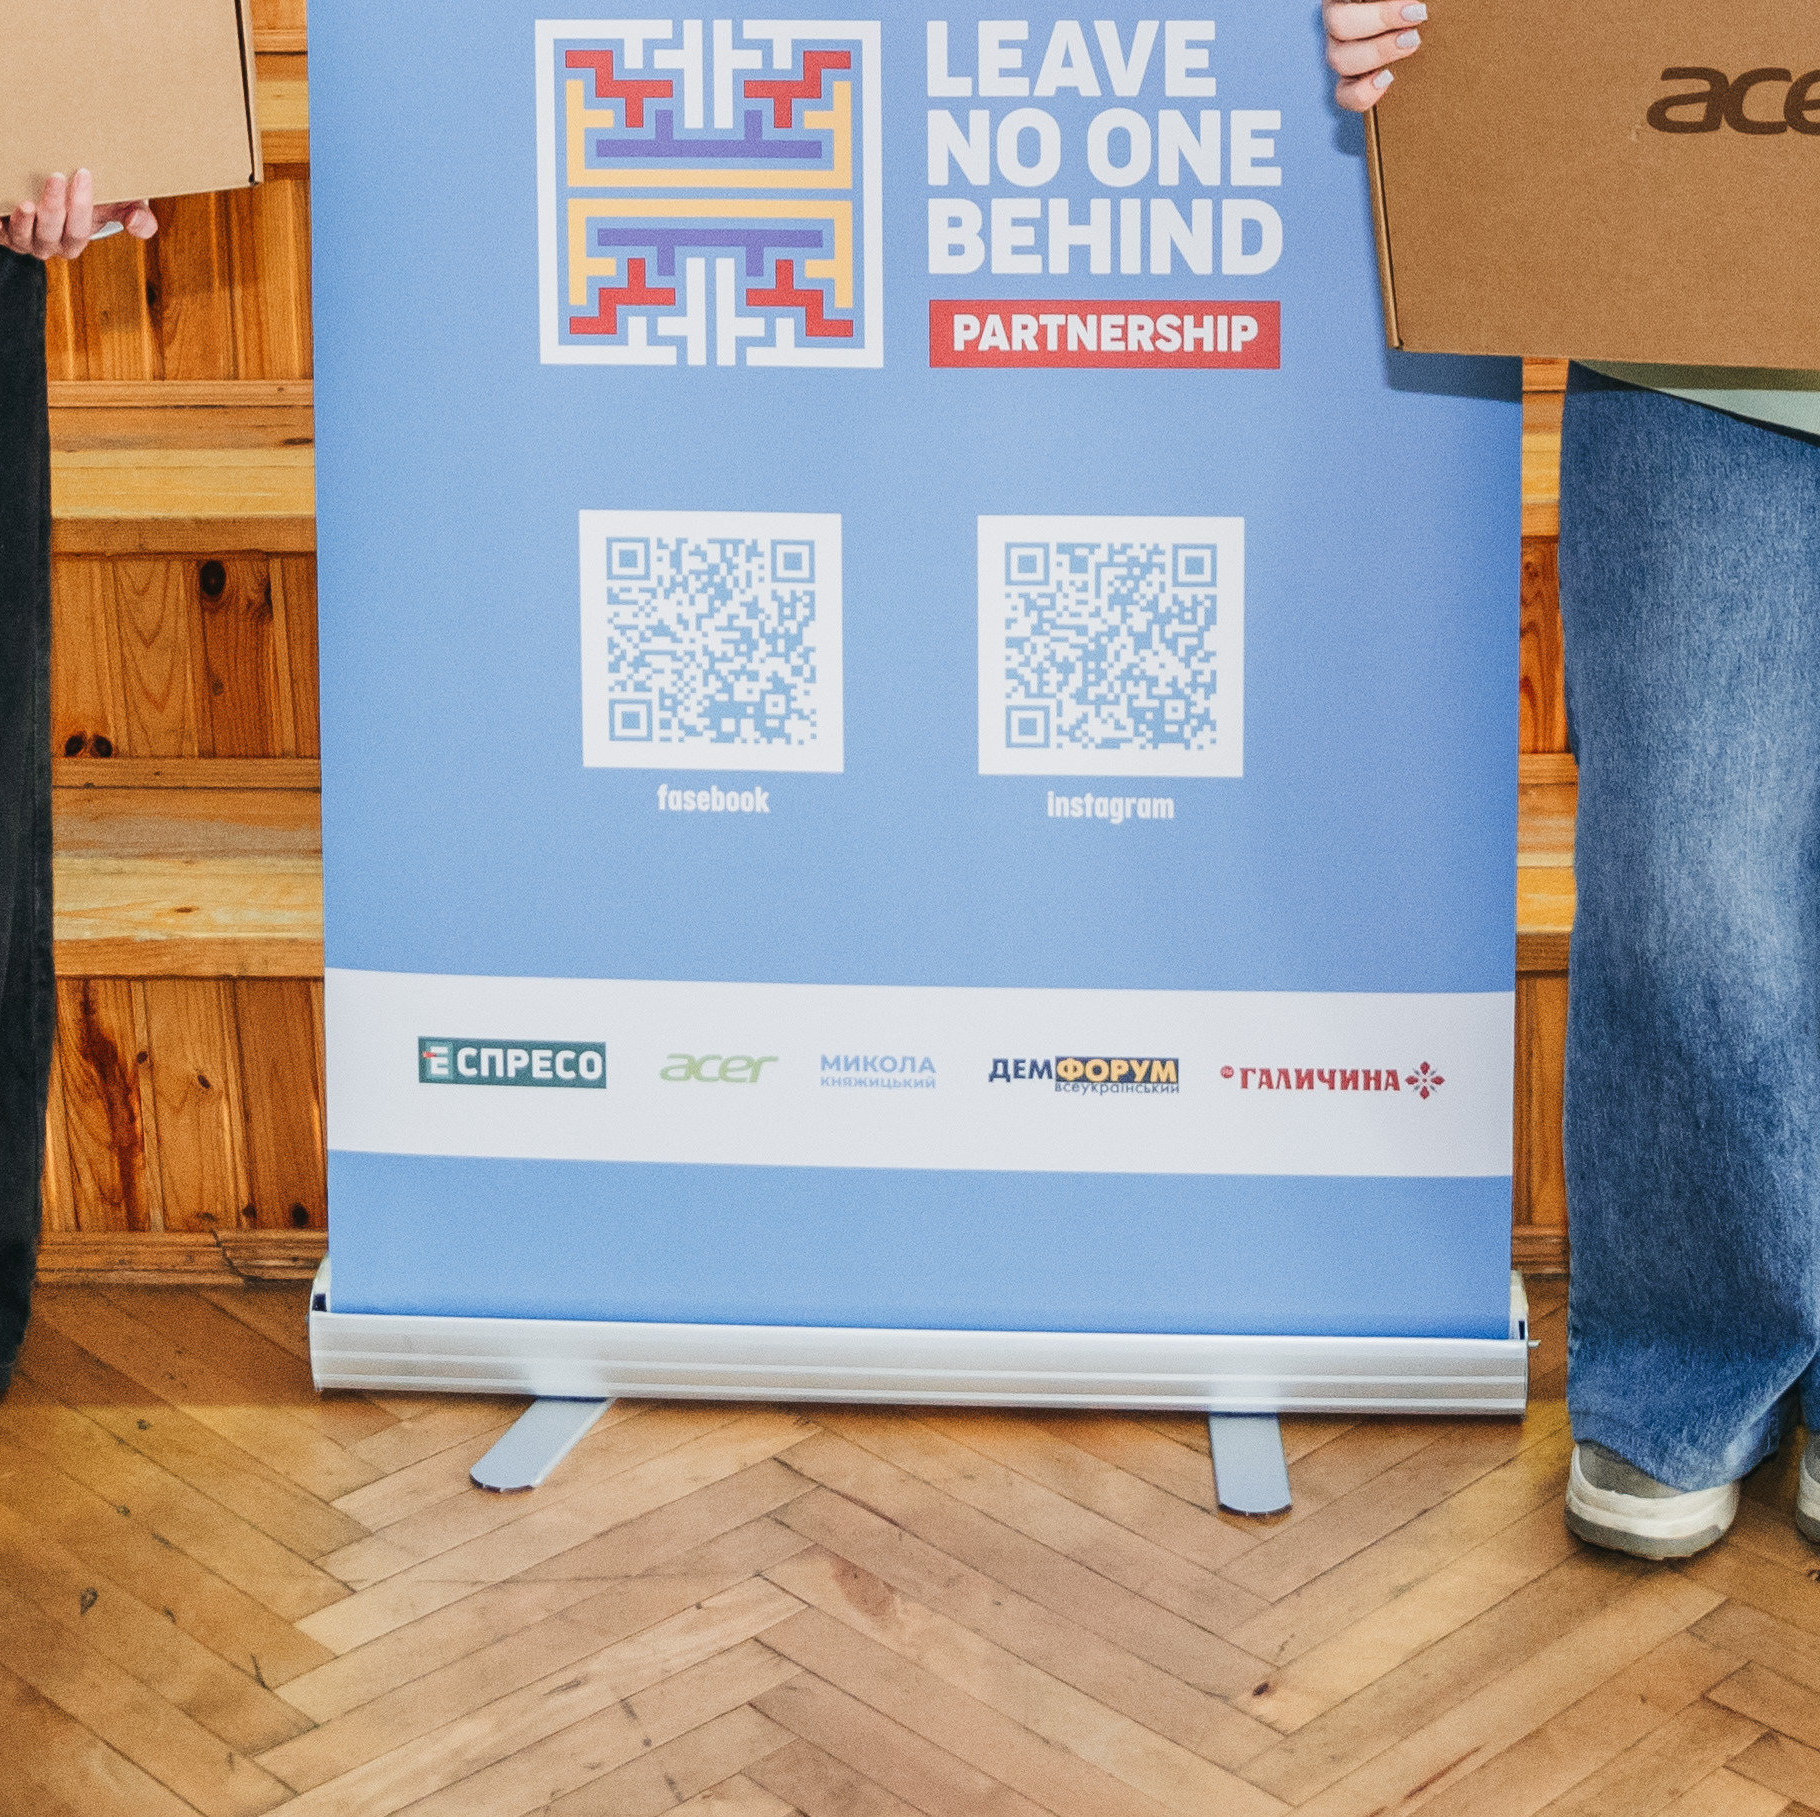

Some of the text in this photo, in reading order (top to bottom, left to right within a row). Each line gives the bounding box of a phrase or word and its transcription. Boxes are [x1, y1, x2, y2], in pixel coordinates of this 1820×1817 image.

[926, 19, 1217, 98] LEAVE
[927, 107, 1282, 188] NO ONE
[927, 197, 1283, 275] BEHIND
[953, 313, 1259, 353] PARTNERSHIP
[656, 783, 770, 814] fasebook
[1046, 790, 1175, 825] instagram
[429, 1045, 604, 1081] ЕСПРЕСО
[659, 1053, 779, 1085] acer
[820, 1054, 936, 1074] МИКОЛА
[988, 1056, 1179, 1084] ДЕМФОРУМ
[820, 1076, 937, 1089] КНЯЖИЦЬКИЙ
[1055, 1082, 1180, 1096] всеукраїнський
[1240, 1068, 1401, 1092] ГАЛИЧИНА
